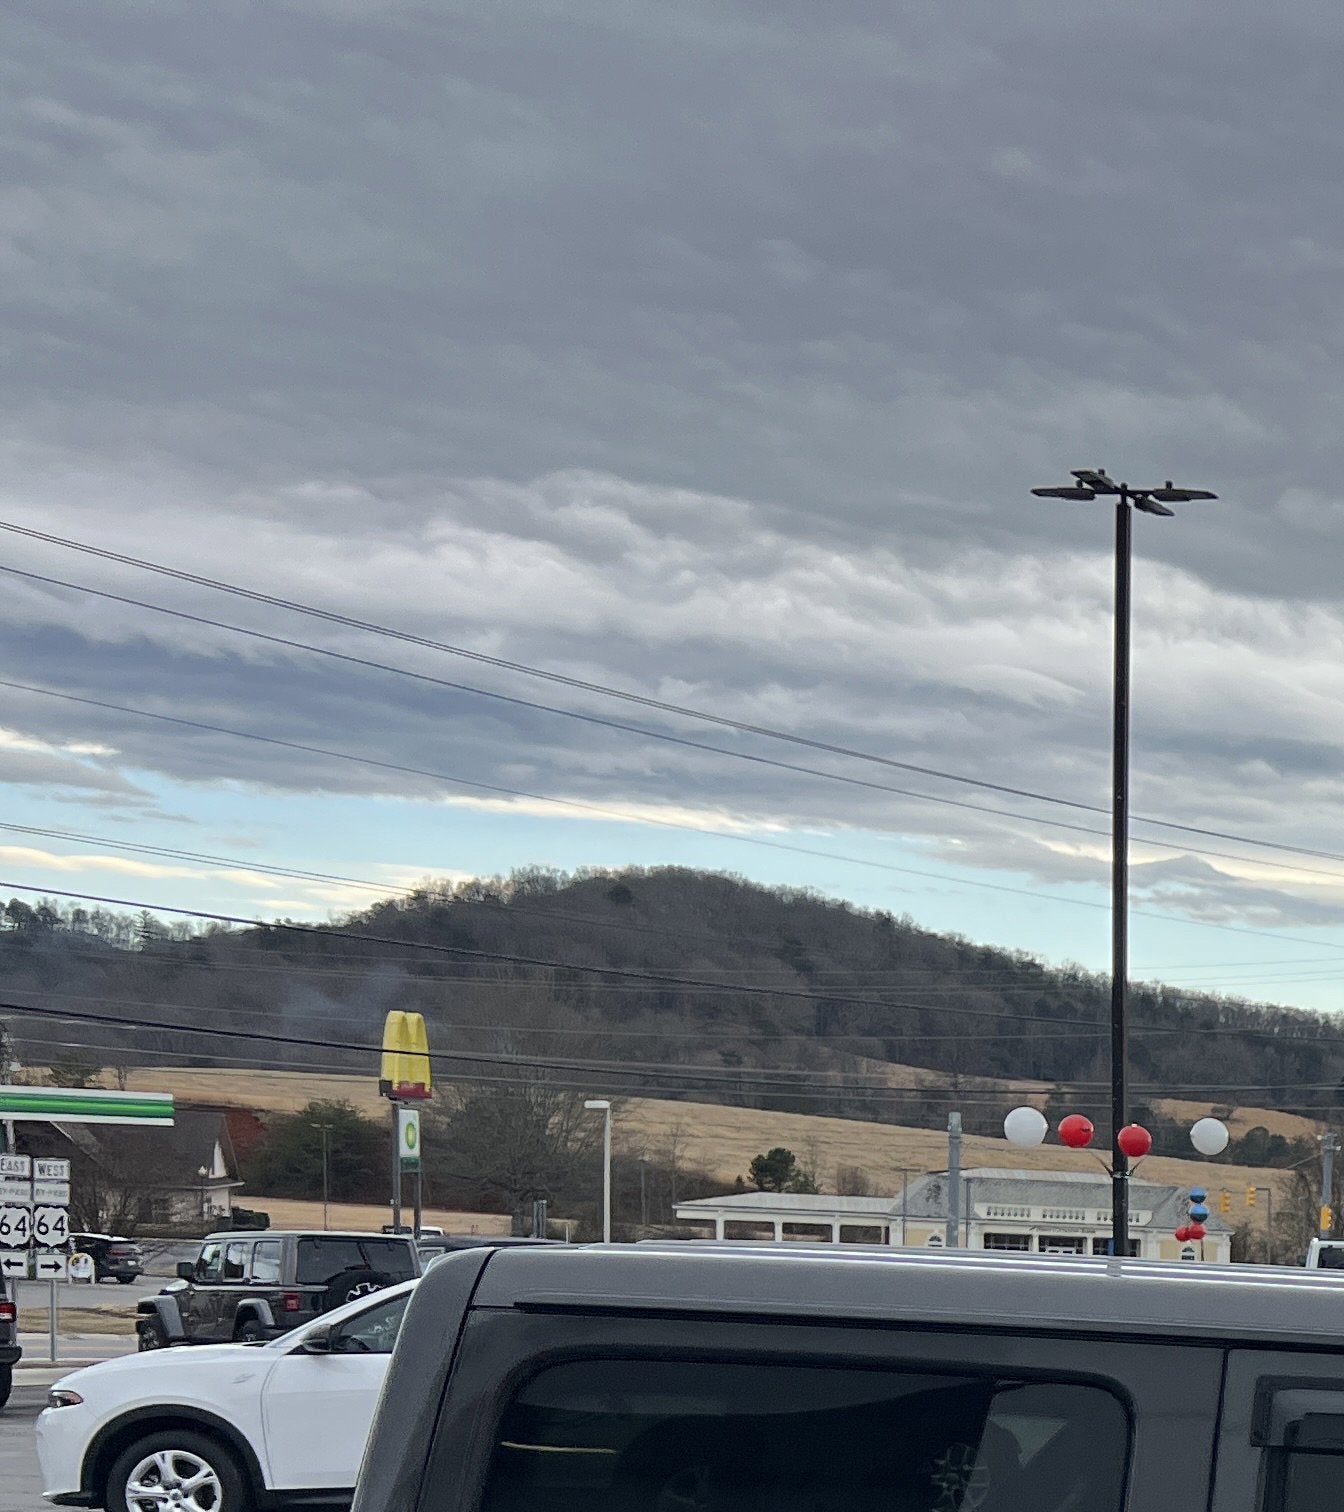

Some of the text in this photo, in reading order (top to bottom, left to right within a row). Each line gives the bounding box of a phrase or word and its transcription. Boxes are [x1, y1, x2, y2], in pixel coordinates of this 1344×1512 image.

[1, 1157, 25, 1172] EAST
[38, 1163, 65, 1176] WEST
[0, 1214, 27, 1237] 64
[37, 1214, 66, 1237] 64
